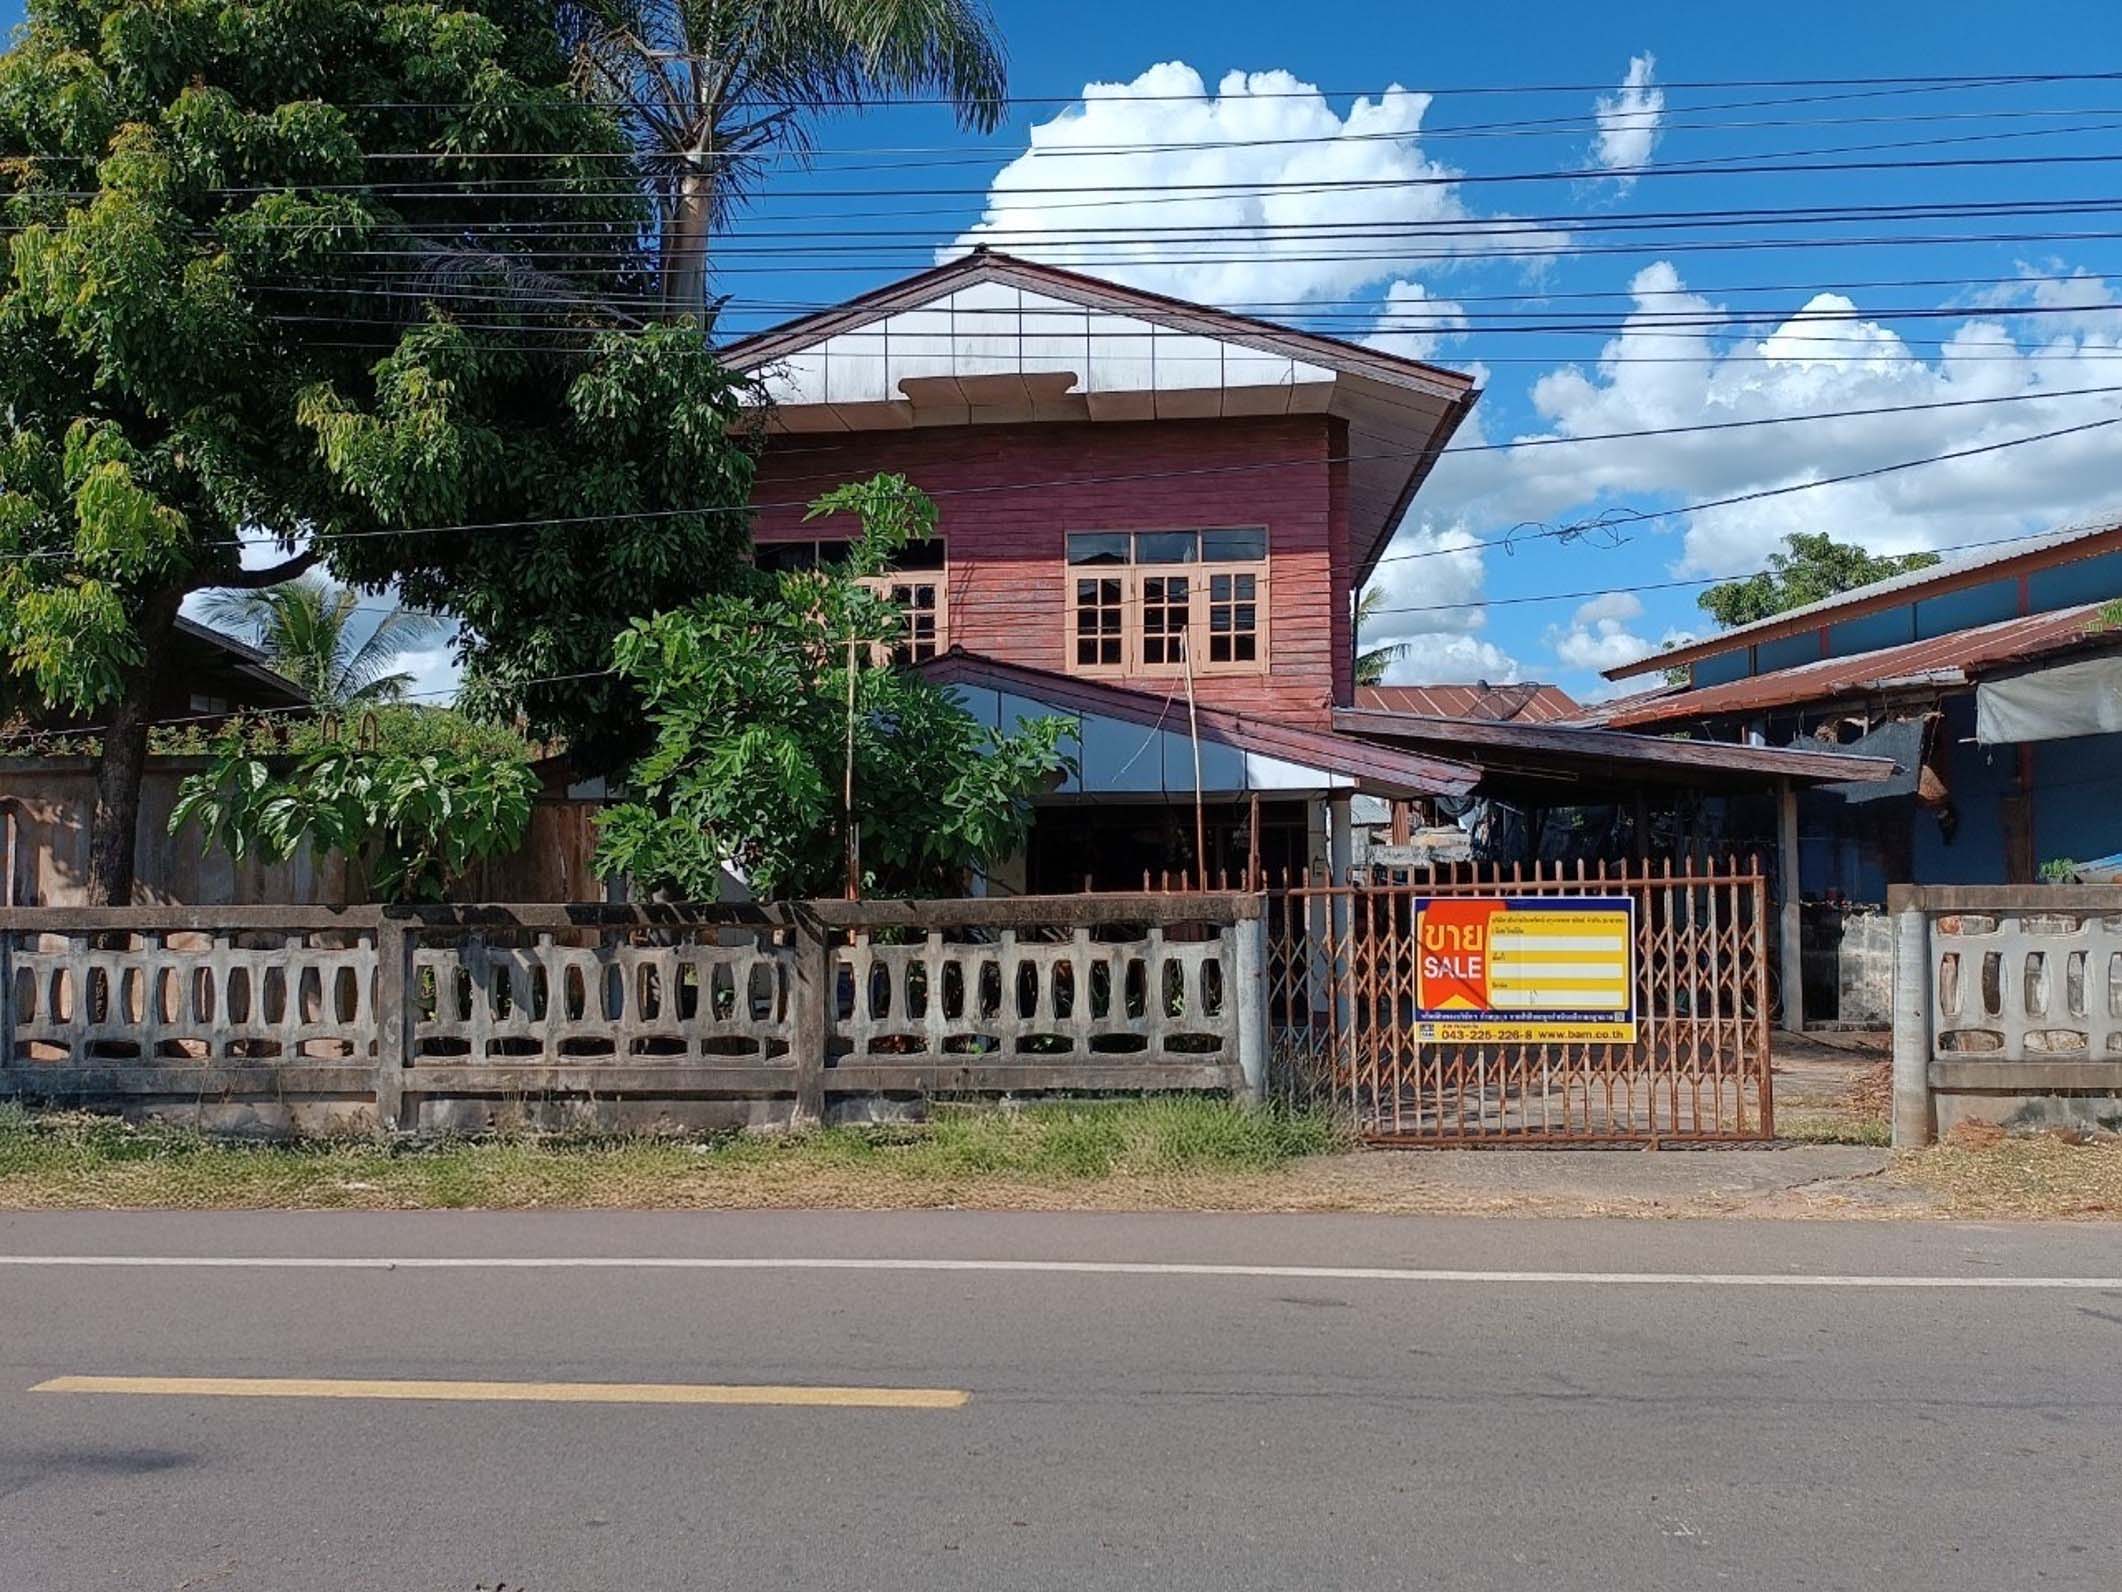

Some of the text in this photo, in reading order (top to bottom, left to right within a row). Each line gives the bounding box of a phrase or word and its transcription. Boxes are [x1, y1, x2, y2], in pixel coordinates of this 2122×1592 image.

[1425, 924, 1483, 951] ขาย
[1424, 956, 1482, 978] SALE
[1538, 1029, 1624, 1040] www.bam.co.th
